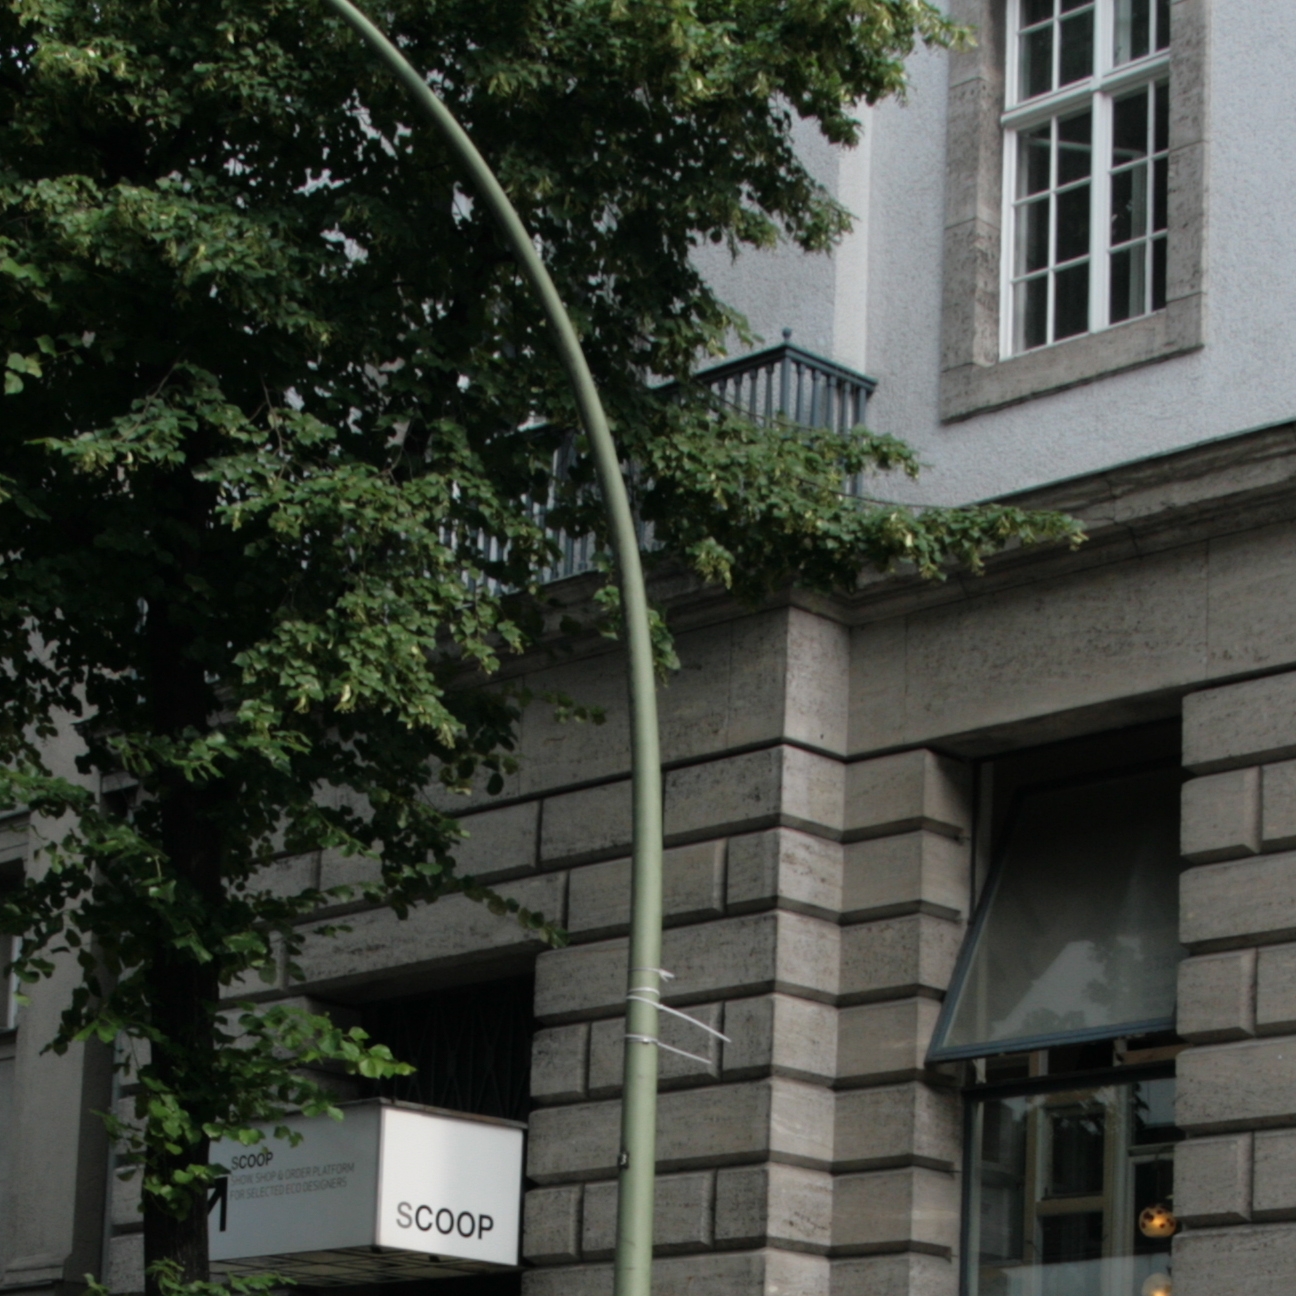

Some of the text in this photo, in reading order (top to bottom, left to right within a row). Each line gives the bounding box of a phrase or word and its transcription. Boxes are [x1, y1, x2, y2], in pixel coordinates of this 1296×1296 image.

[231, 1151, 274, 1171] SCOOP
[255, 1170, 276, 1183] SHOP
[285, 1166, 311, 1180] ORDER
[312, 1162, 355, 1177] PLATFORM
[230, 1176, 347, 1201] FOR SELECTED ECO DESIGNERS
[396, 1201, 494, 1240] SCOOP
